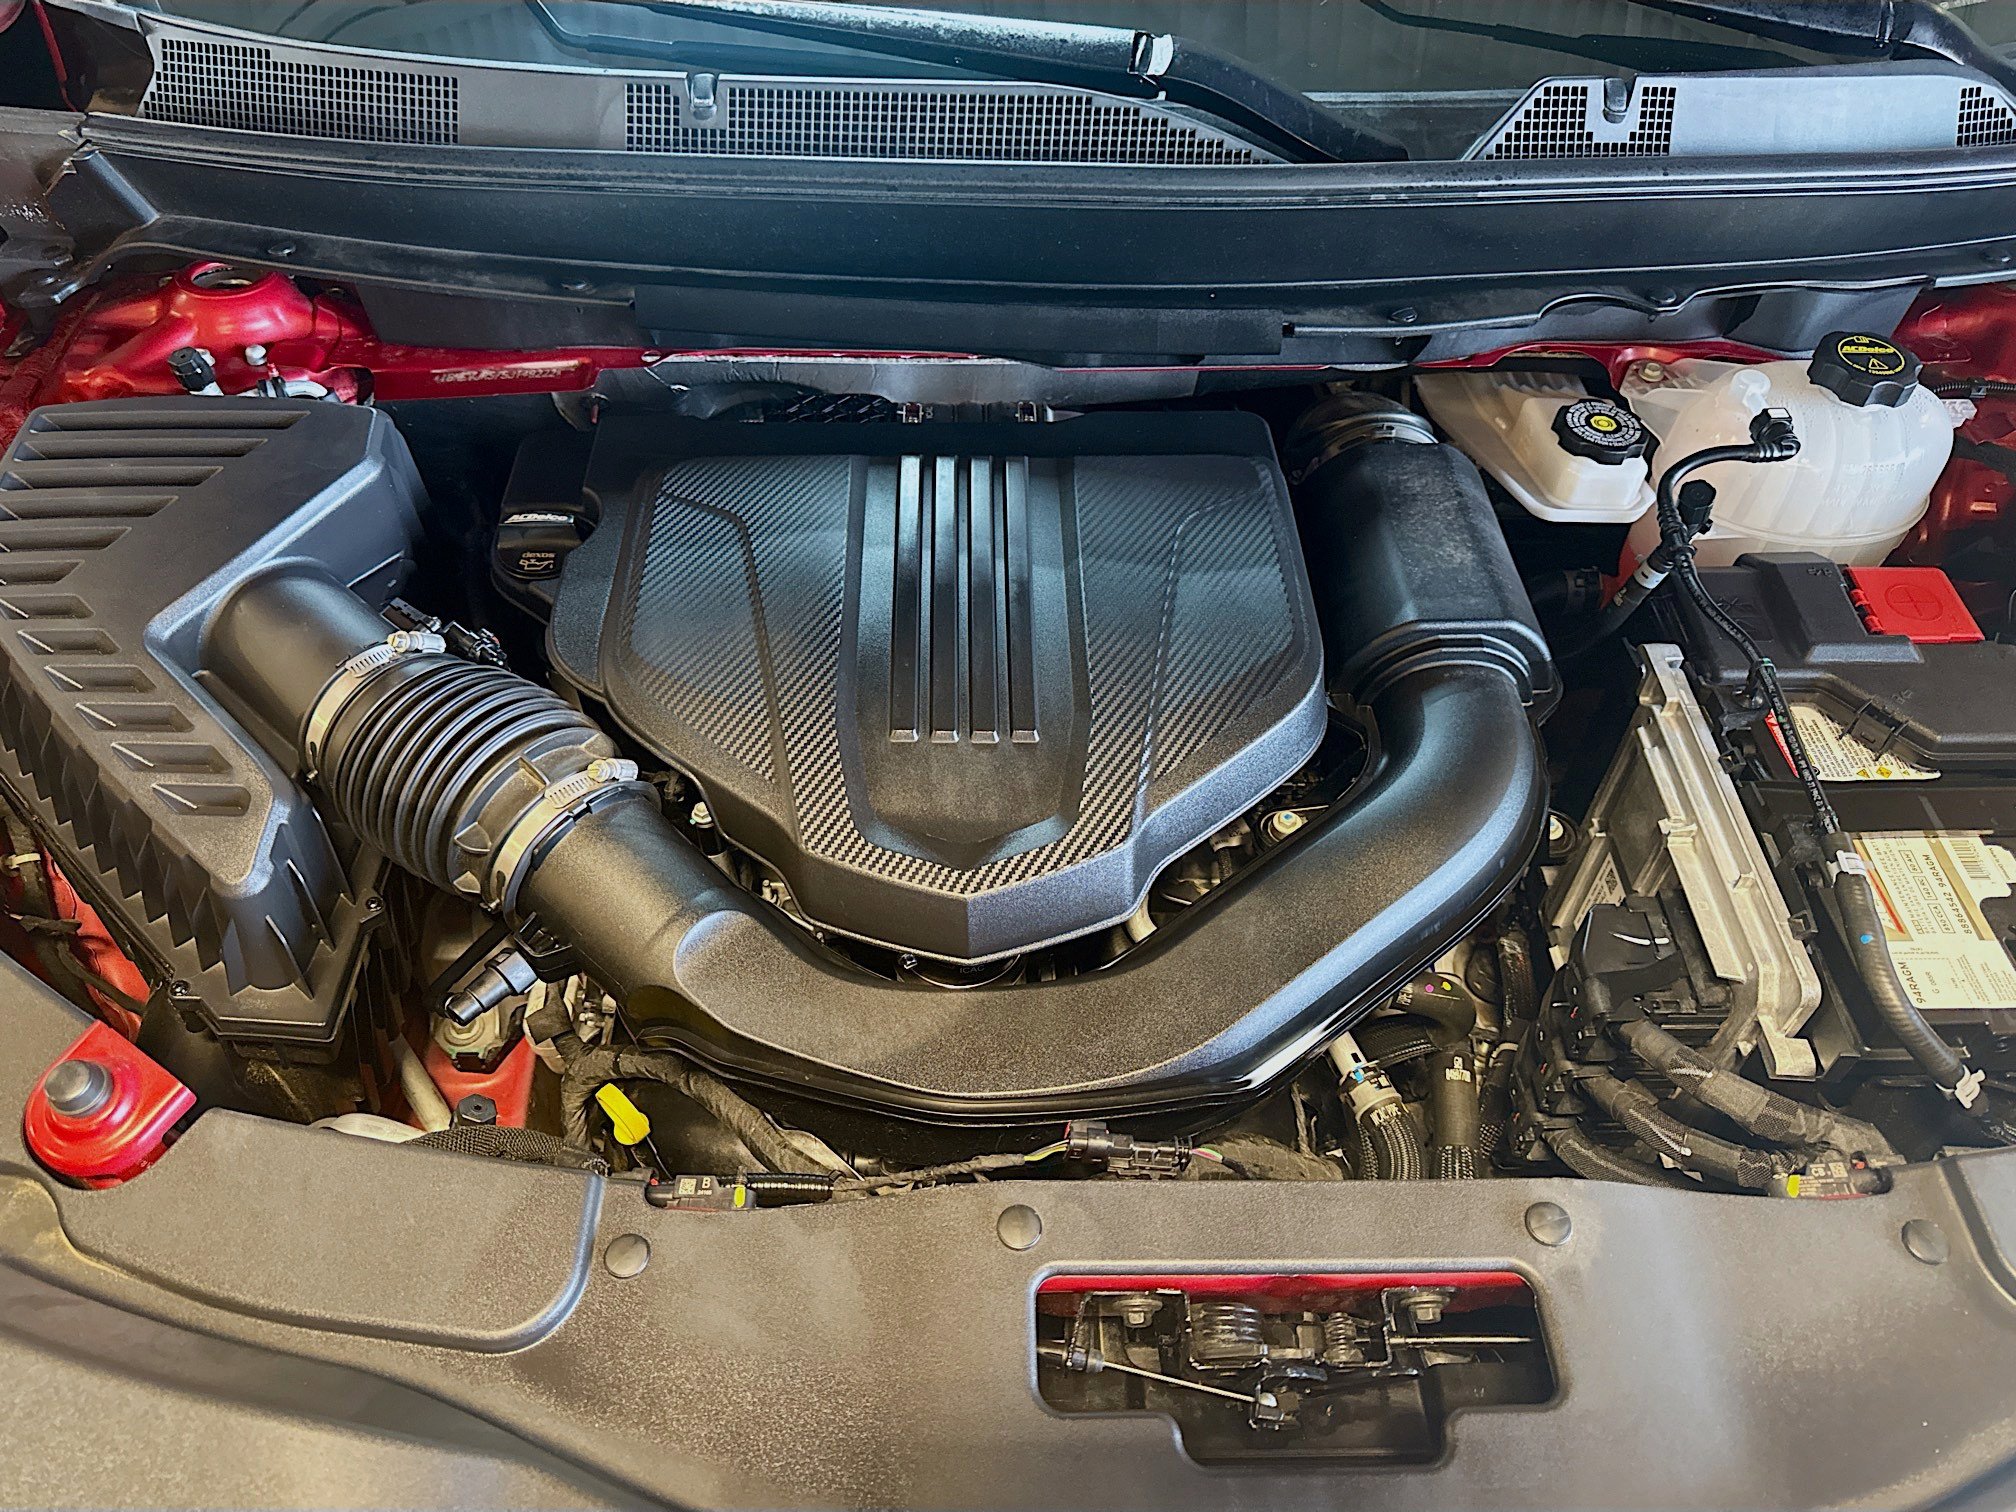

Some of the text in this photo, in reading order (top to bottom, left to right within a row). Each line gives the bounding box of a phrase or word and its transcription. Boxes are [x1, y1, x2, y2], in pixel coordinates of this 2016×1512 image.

[1841, 345, 1895, 354] ACDelco
[1922, 854, 1947, 887] 94RAGM
[1943, 892, 1972, 934] 88864542
[959, 965, 984, 973] ICAC
[1898, 962, 1926, 1003] 94RAGM
[701, 1177, 711, 1188] B
